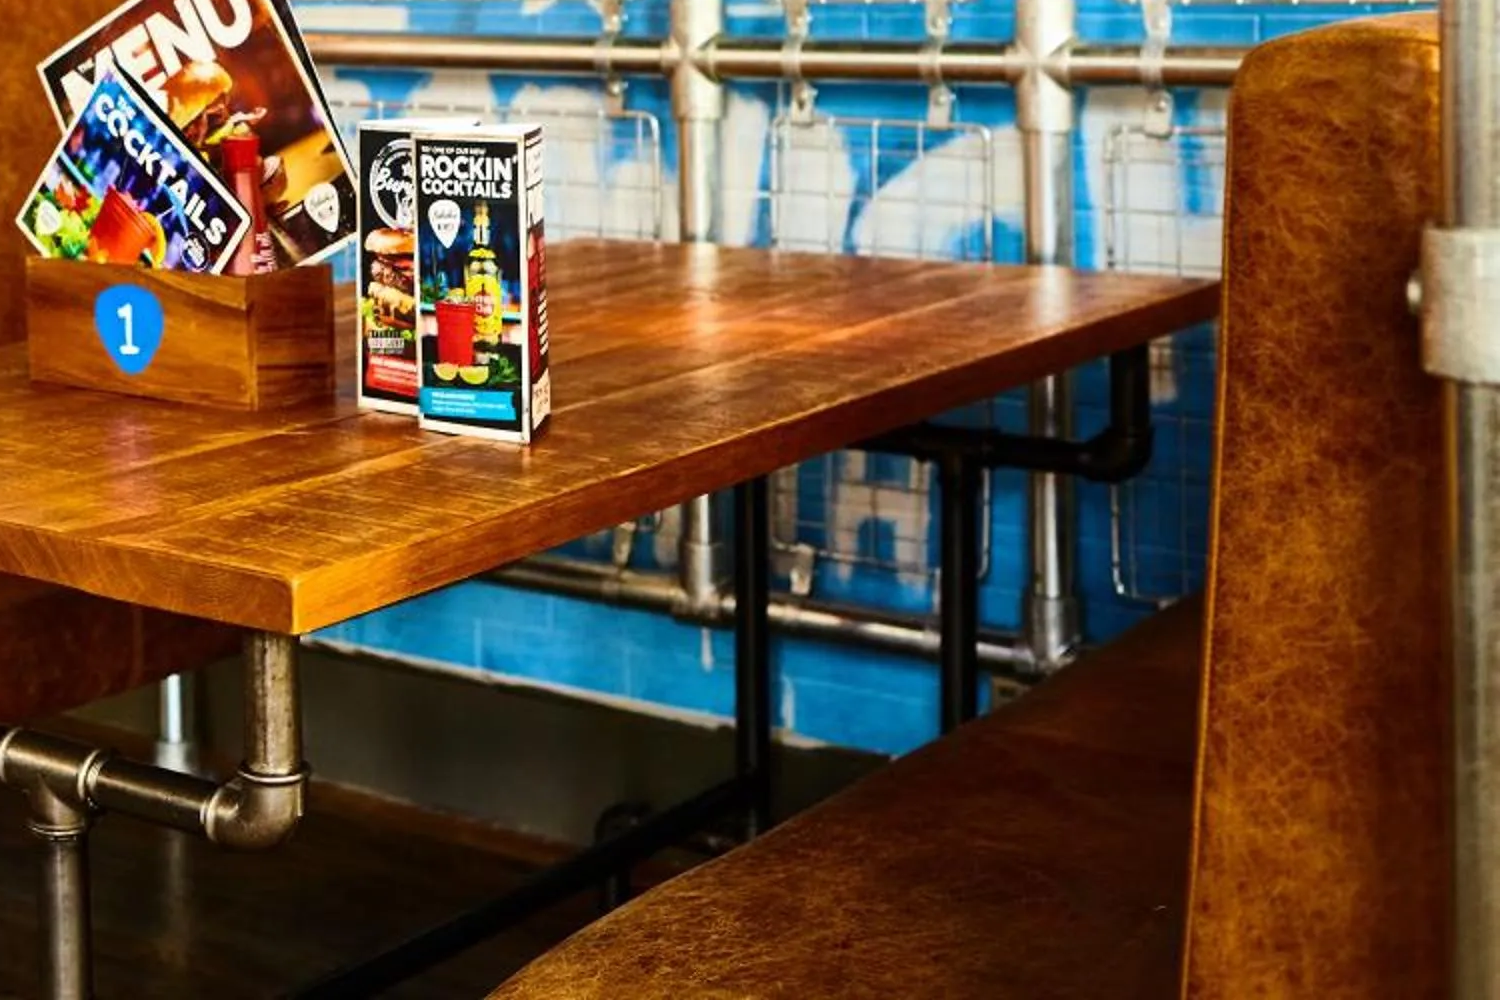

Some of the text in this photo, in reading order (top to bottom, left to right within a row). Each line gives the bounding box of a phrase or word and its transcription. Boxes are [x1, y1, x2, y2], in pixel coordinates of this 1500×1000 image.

[95, 92, 228, 246] COCKTAILS
[420, 154, 518, 181] ROCKIN'
[421, 178, 512, 199] COCKTAILS
[116, 304, 141, 356] 1
